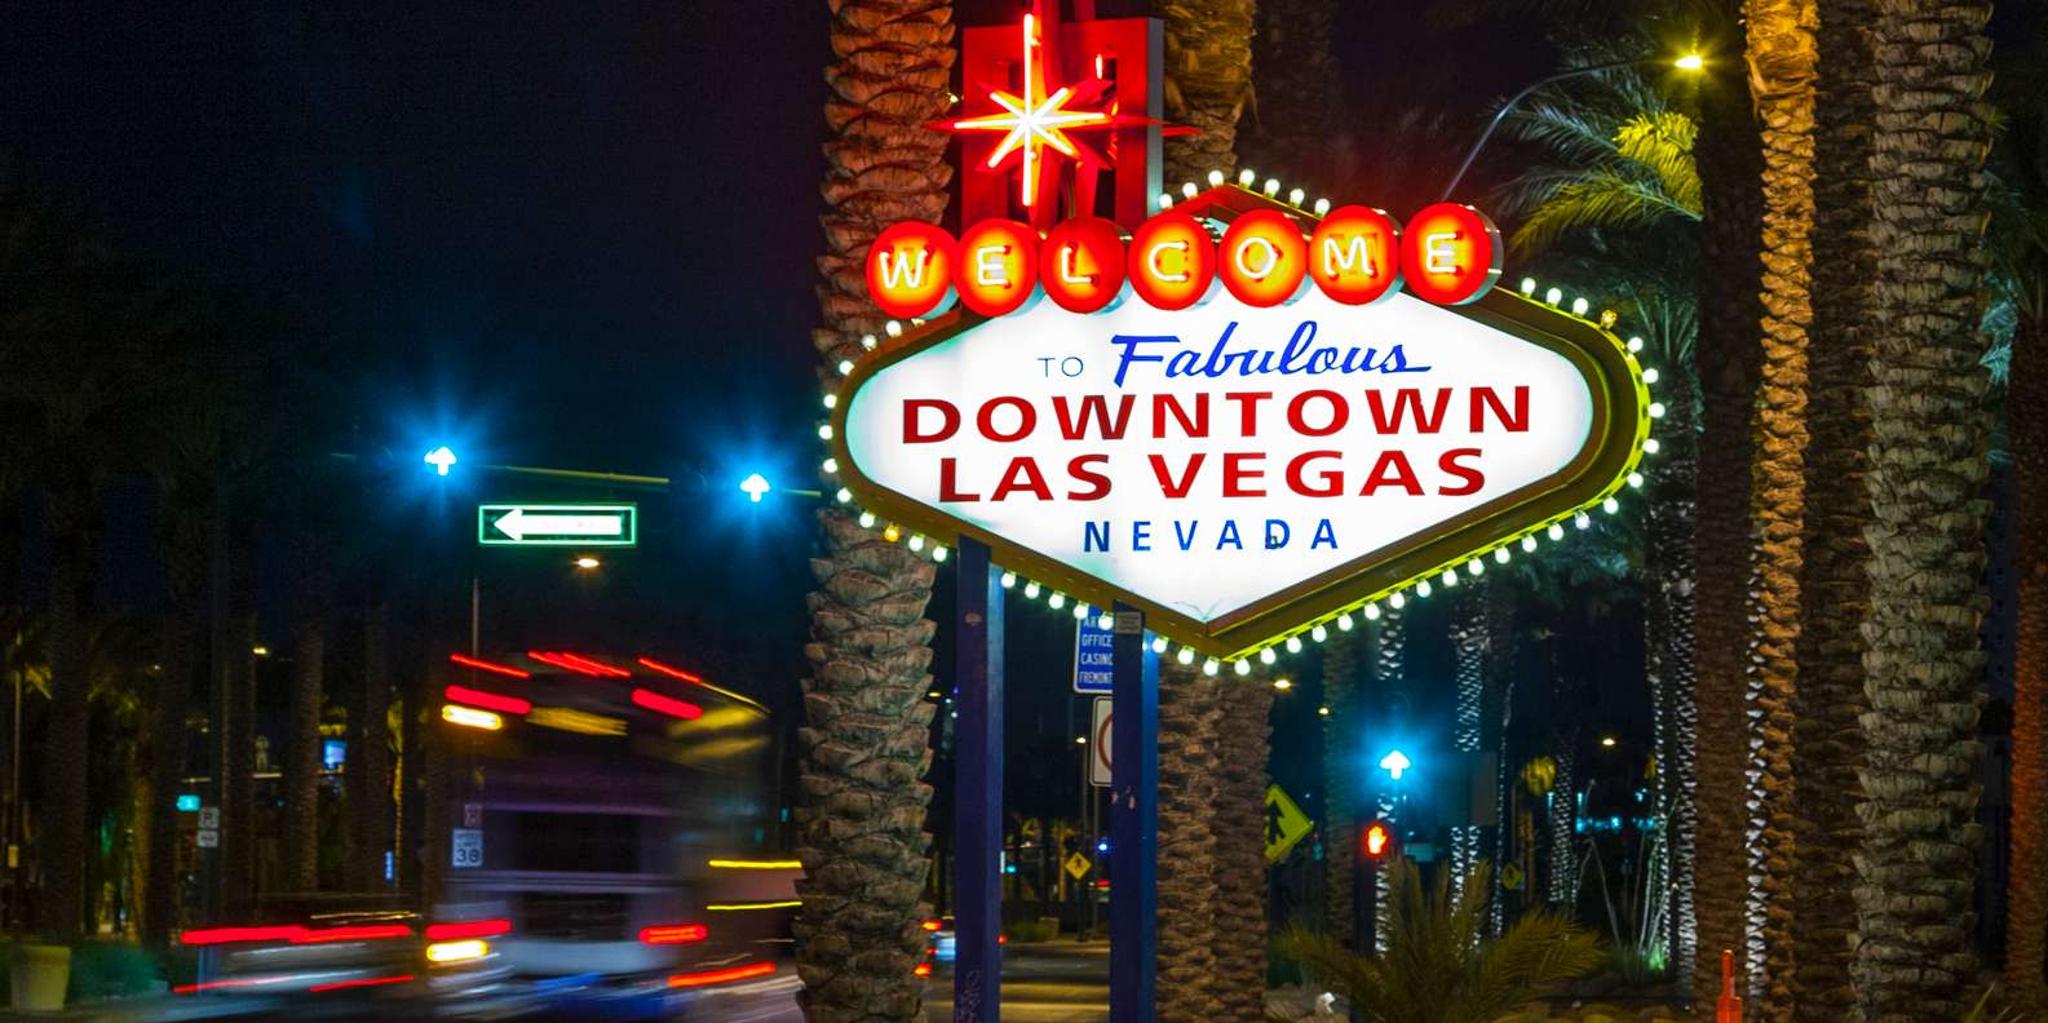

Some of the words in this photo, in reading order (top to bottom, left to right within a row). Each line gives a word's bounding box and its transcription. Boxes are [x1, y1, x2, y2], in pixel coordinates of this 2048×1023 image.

[879, 233, 1462, 290] WELCOME
[1038, 356, 1084, 378] TO
[1111, 320, 1432, 388] Fabulous
[903, 386, 1530, 445] DOWNTOWN
[939, 454, 1112, 503] LAS
[1148, 447, 1486, 499] VEGAS
[1084, 519, 1339, 553] NEVADA
[1081, 634, 1112, 647] OFFICE
